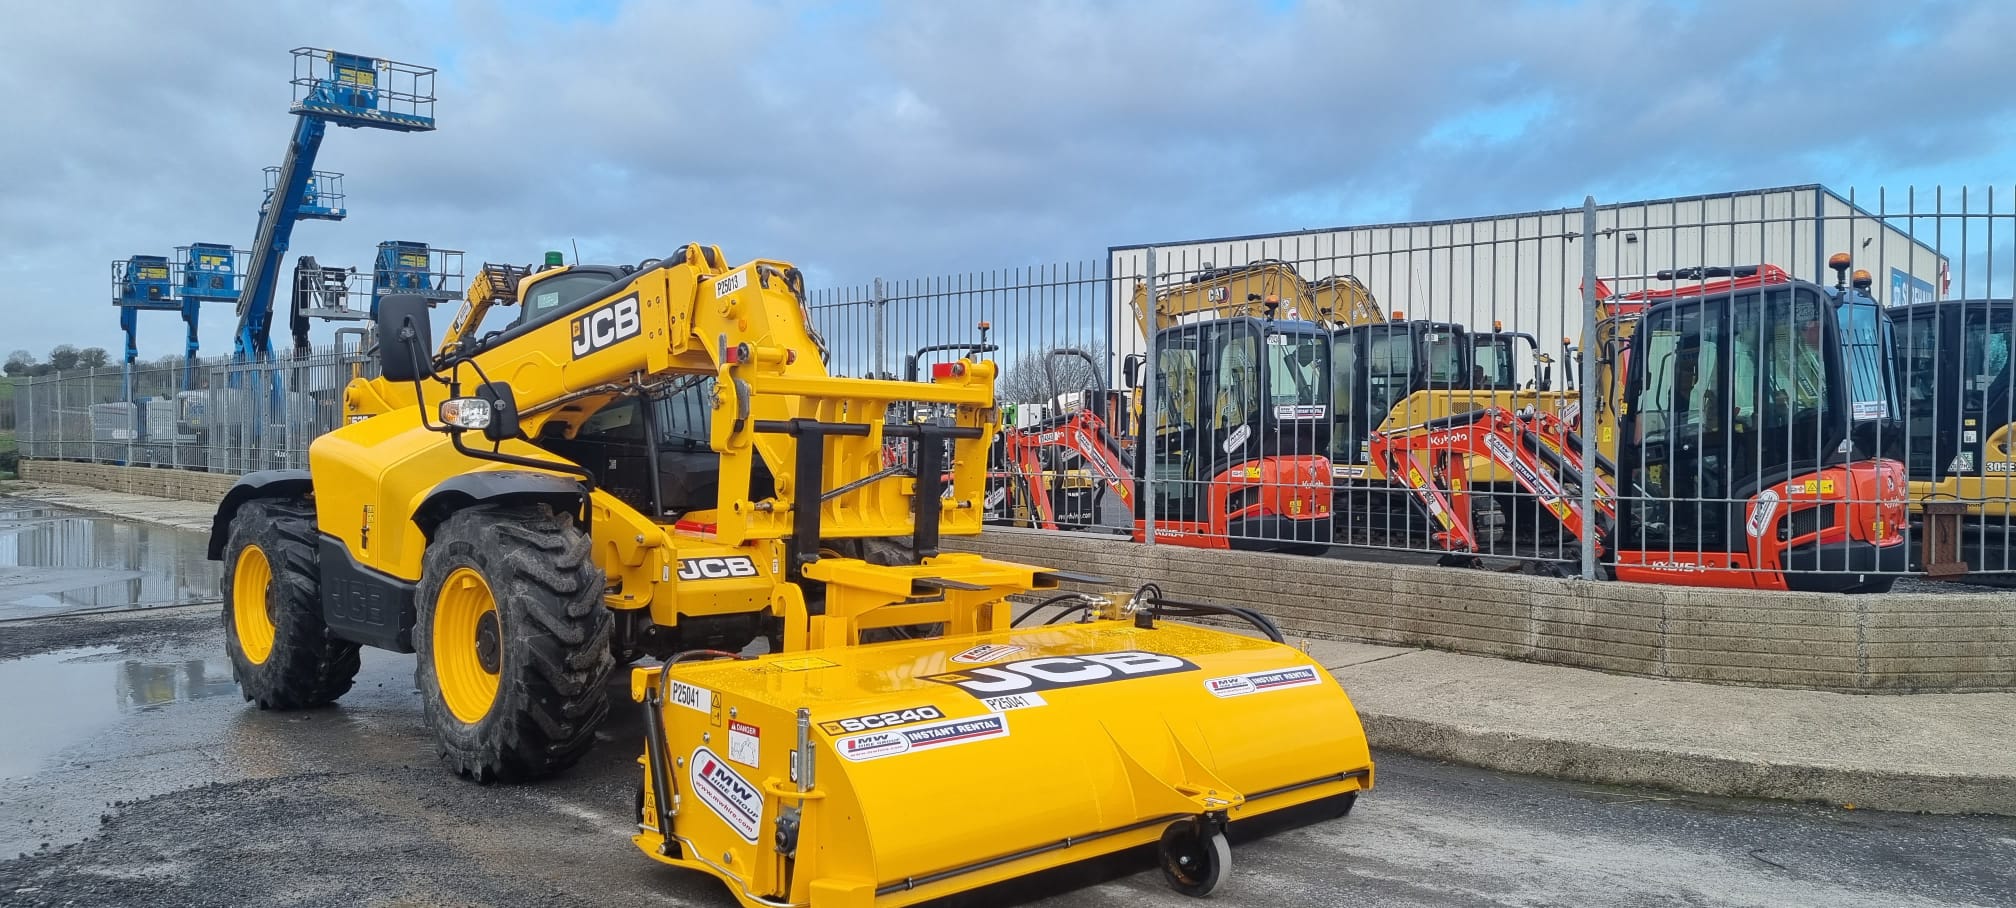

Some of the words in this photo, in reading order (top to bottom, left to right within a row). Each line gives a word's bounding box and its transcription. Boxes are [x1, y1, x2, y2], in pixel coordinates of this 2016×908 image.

[717, 275, 738, 296] P25013
[1208, 287, 1224, 302] CAT
[573, 297, 639, 356] JCB
[1986, 462, 2016, 472] 305E
[679, 557, 756, 580] JCB
[956, 652, 1184, 693] JCB
[673, 682, 699, 708] P25041
[985, 695, 1031, 711] P25041
[736, 723, 756, 735] DANGER
[840, 706, 940, 733] SC240
[909, 726, 955, 741] INSTANT
[956, 720, 998, 734] RENTAL
[858, 734, 889, 744] MW
[715, 768, 752, 800] MW
[696, 780, 753, 833] www.mwhire.com
[711, 777, 730, 794] HIRE
[731, 794, 758, 818] GROUP
